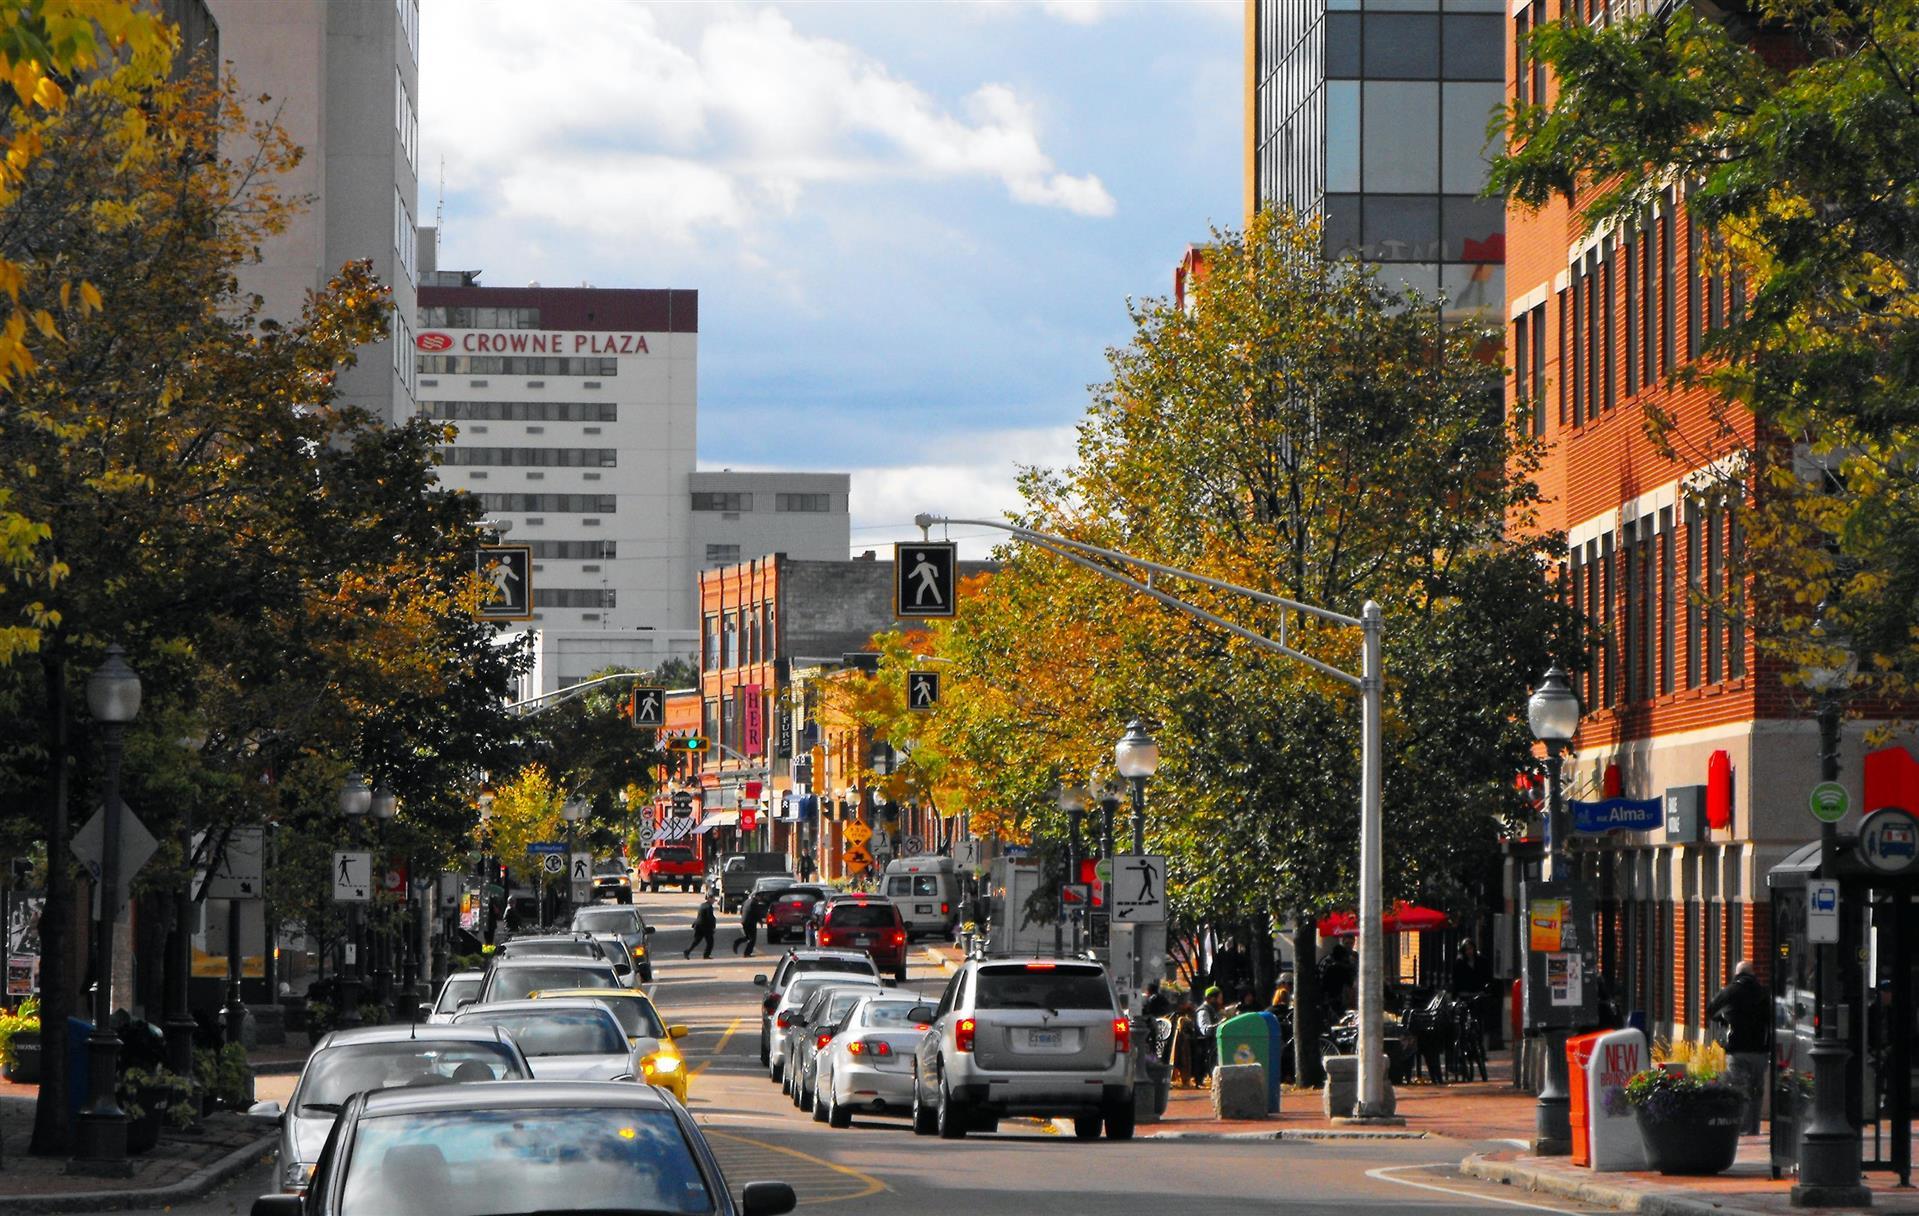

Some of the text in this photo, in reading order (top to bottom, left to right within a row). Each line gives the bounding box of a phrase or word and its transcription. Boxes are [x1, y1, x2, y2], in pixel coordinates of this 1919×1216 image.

[463, 333, 649, 354] CROWNE PLAZA
[749, 692, 758, 745] HER
[1609, 806, 1645, 822] Alma
[1605, 1043, 1638, 1072] NEW
